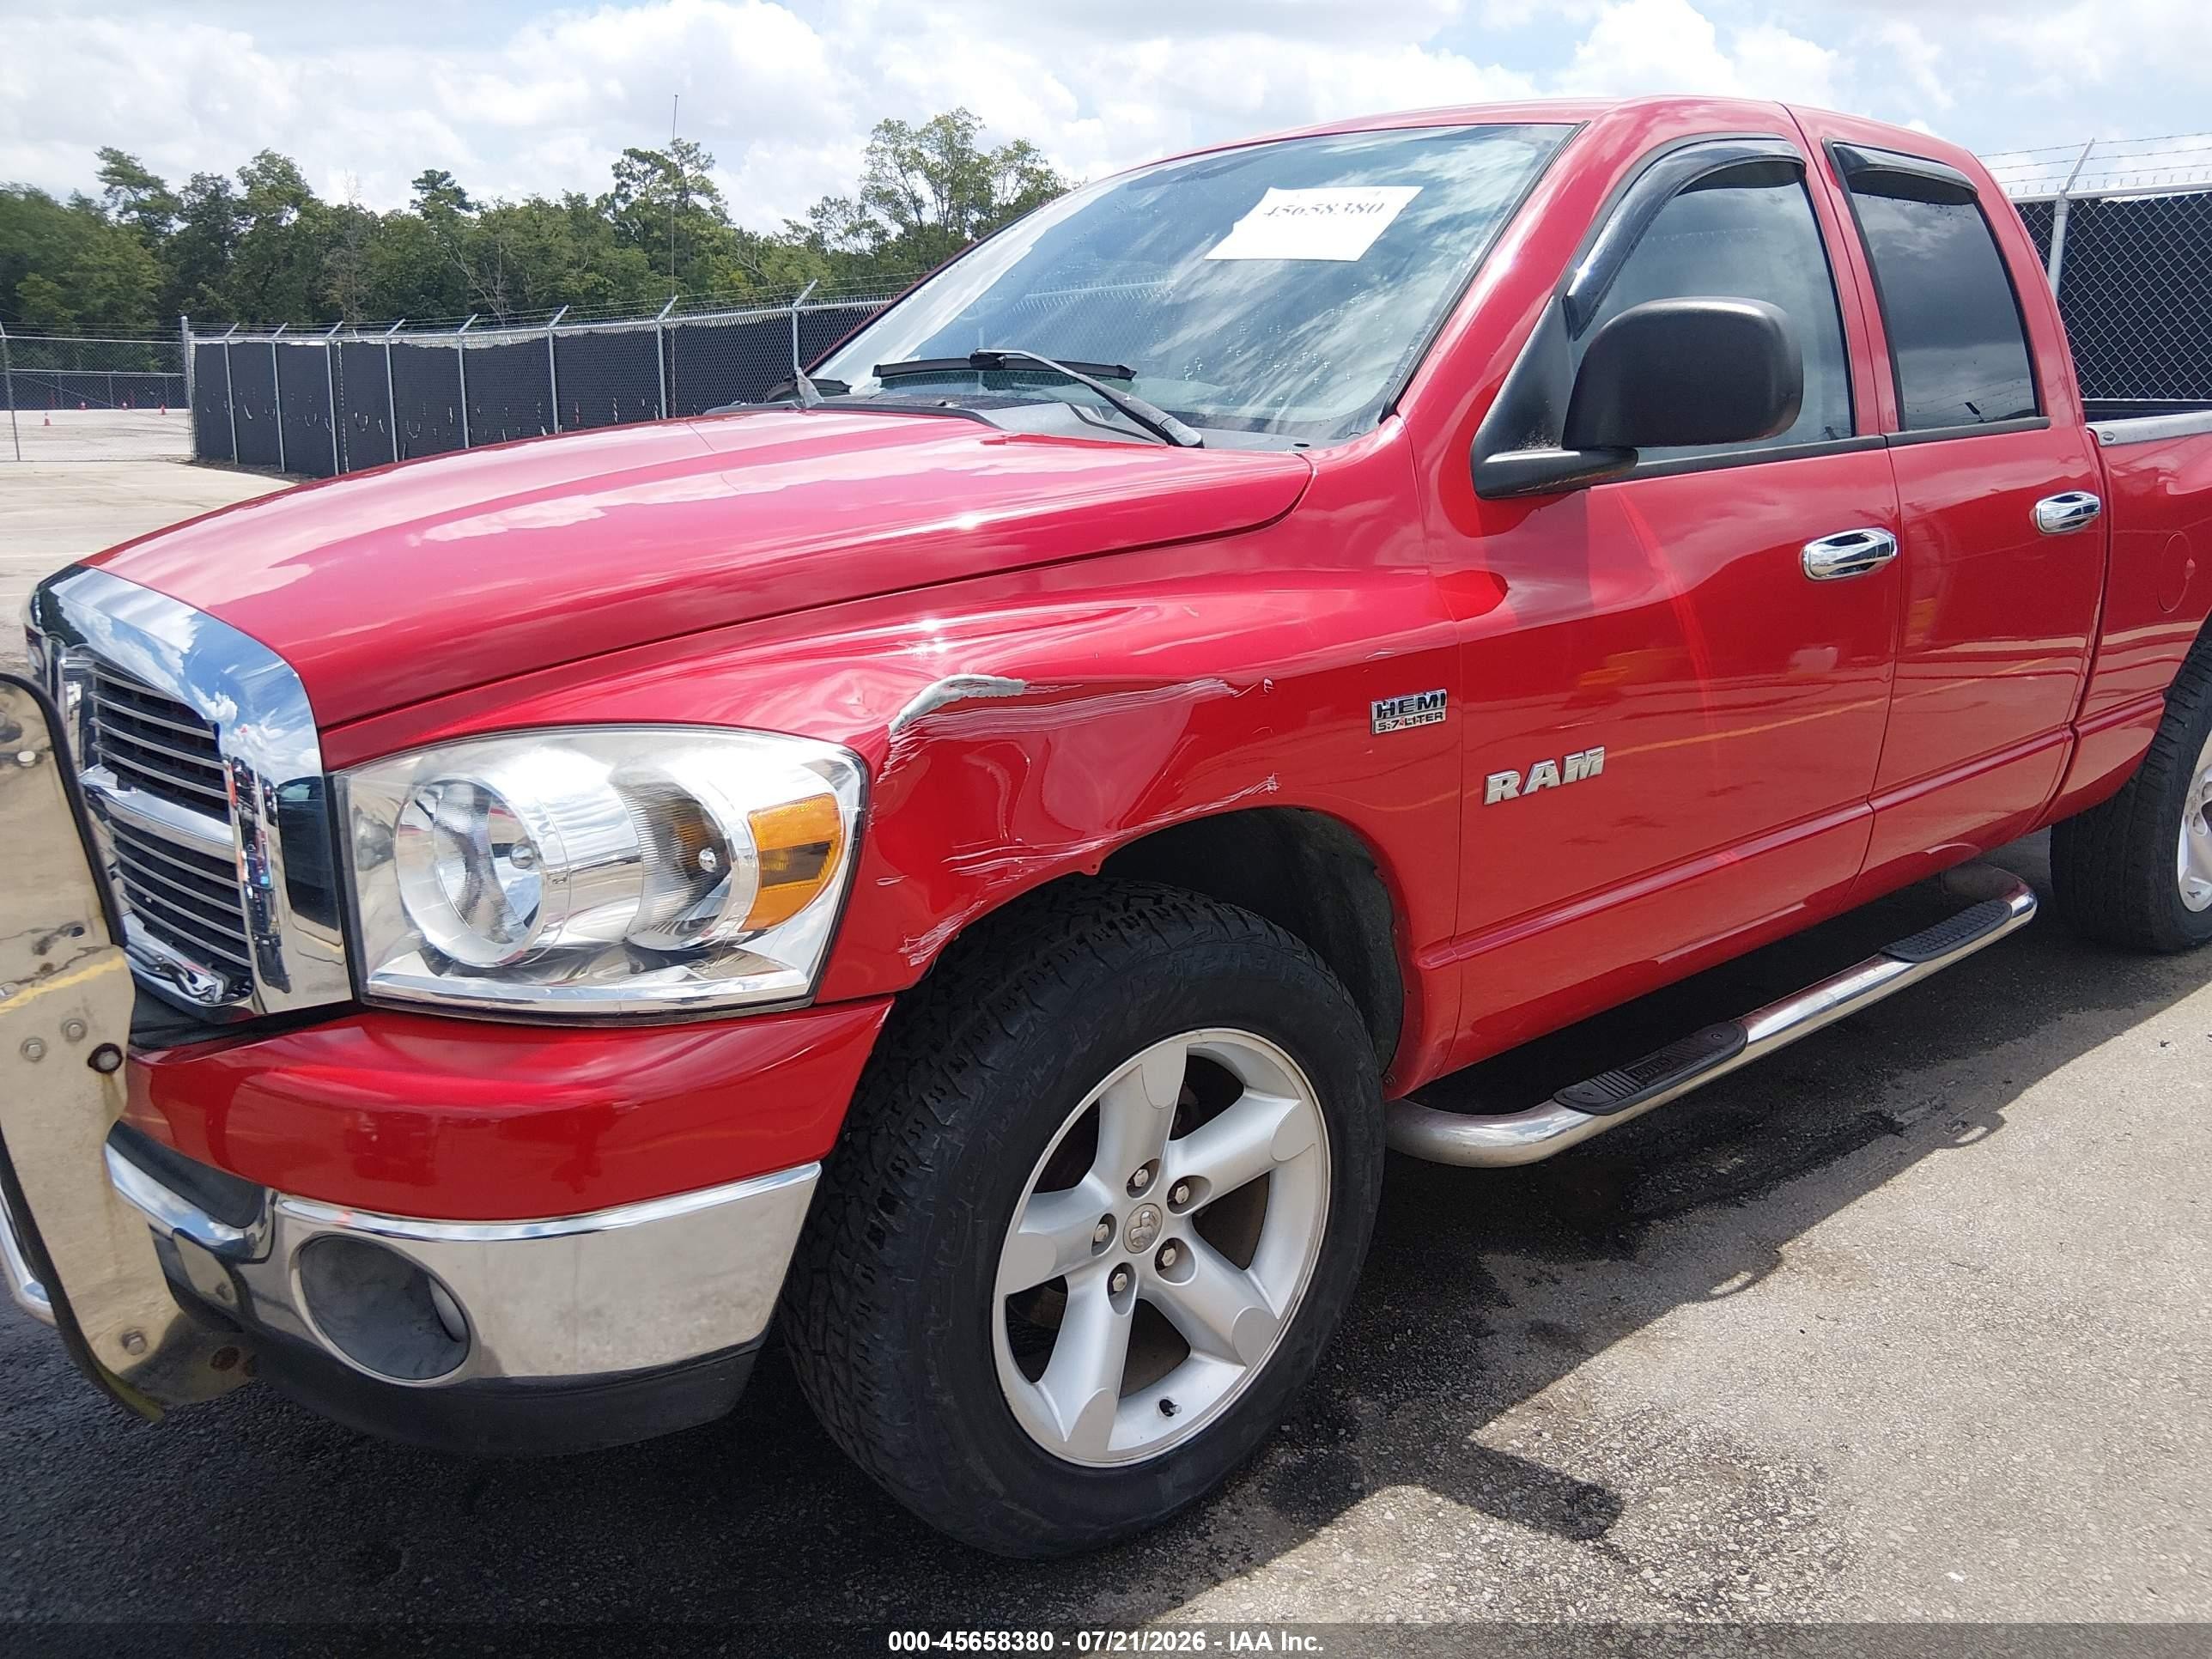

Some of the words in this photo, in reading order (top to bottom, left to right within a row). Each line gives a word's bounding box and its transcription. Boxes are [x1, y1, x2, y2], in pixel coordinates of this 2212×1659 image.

[1376, 690, 1446, 719] HEMI
[1404, 711, 1443, 726] LITER
[1483, 745, 1606, 805] RAM
